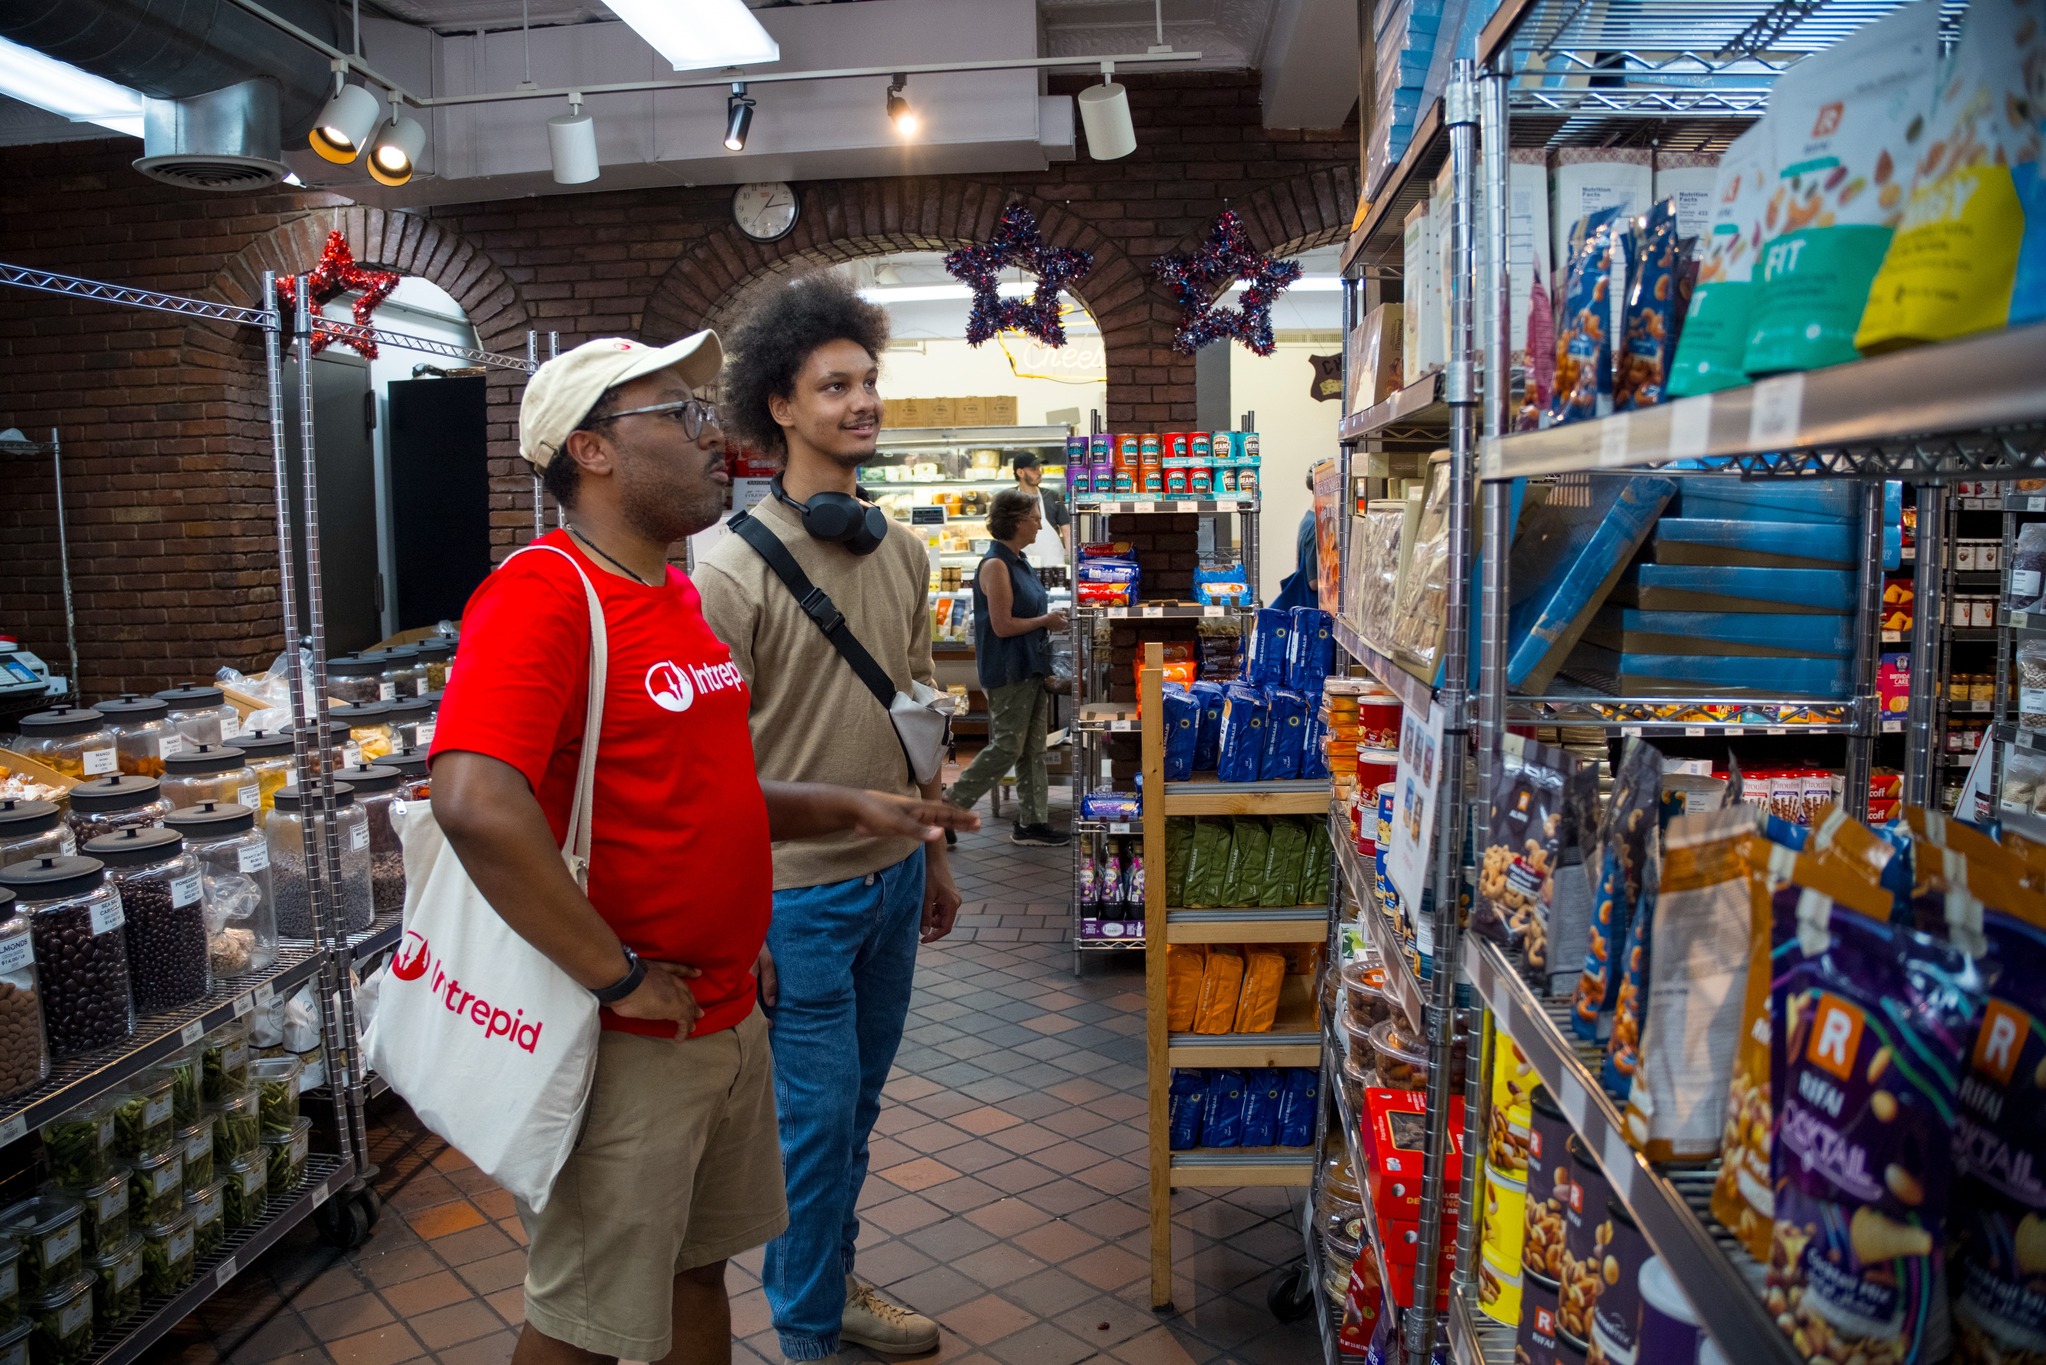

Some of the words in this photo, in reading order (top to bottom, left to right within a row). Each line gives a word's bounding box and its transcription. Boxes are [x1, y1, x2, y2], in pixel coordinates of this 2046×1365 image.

[688, 662, 744, 694] Intrep
[1385, 799, 1391, 808] R
[1869, 787, 1885, 797] coff
[1868, 810, 1885, 820] coff
[430, 958, 543, 1054] Intrepid
[1818, 1008, 1852, 1066] R
[1984, 1013, 2016, 1070] R
[1782, 1098, 1873, 1186] OCKTAIL
[1538, 1310, 1553, 1331] R
[1532, 1332, 1555, 1350] RIFAI
